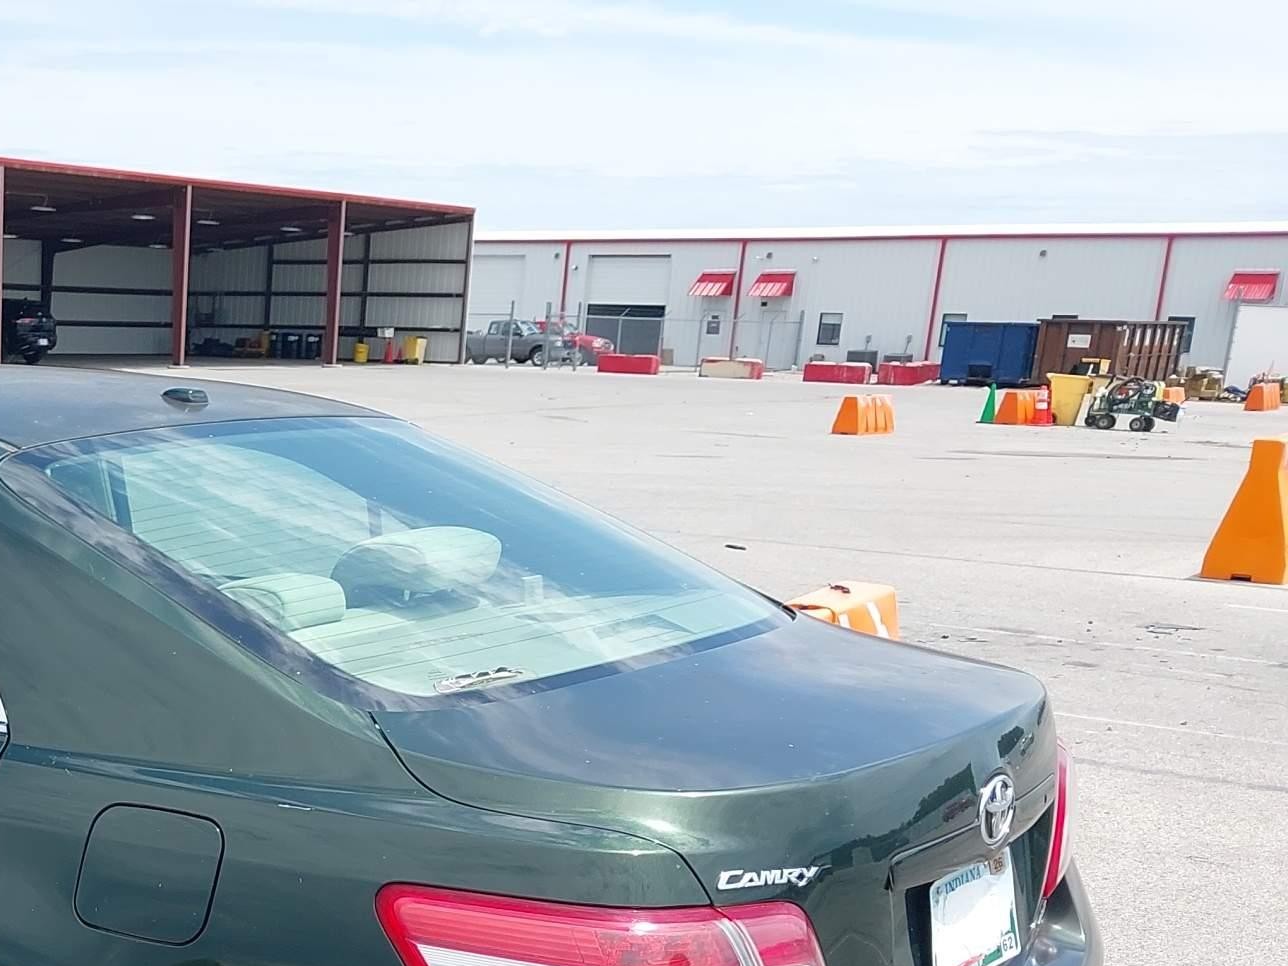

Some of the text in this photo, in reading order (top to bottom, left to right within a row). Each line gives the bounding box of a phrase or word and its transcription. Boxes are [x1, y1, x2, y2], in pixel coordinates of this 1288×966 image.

[716, 865, 822, 891] CAMRY
[944, 864, 983, 895] INDIANA
[1002, 935, 1014, 952] 62
